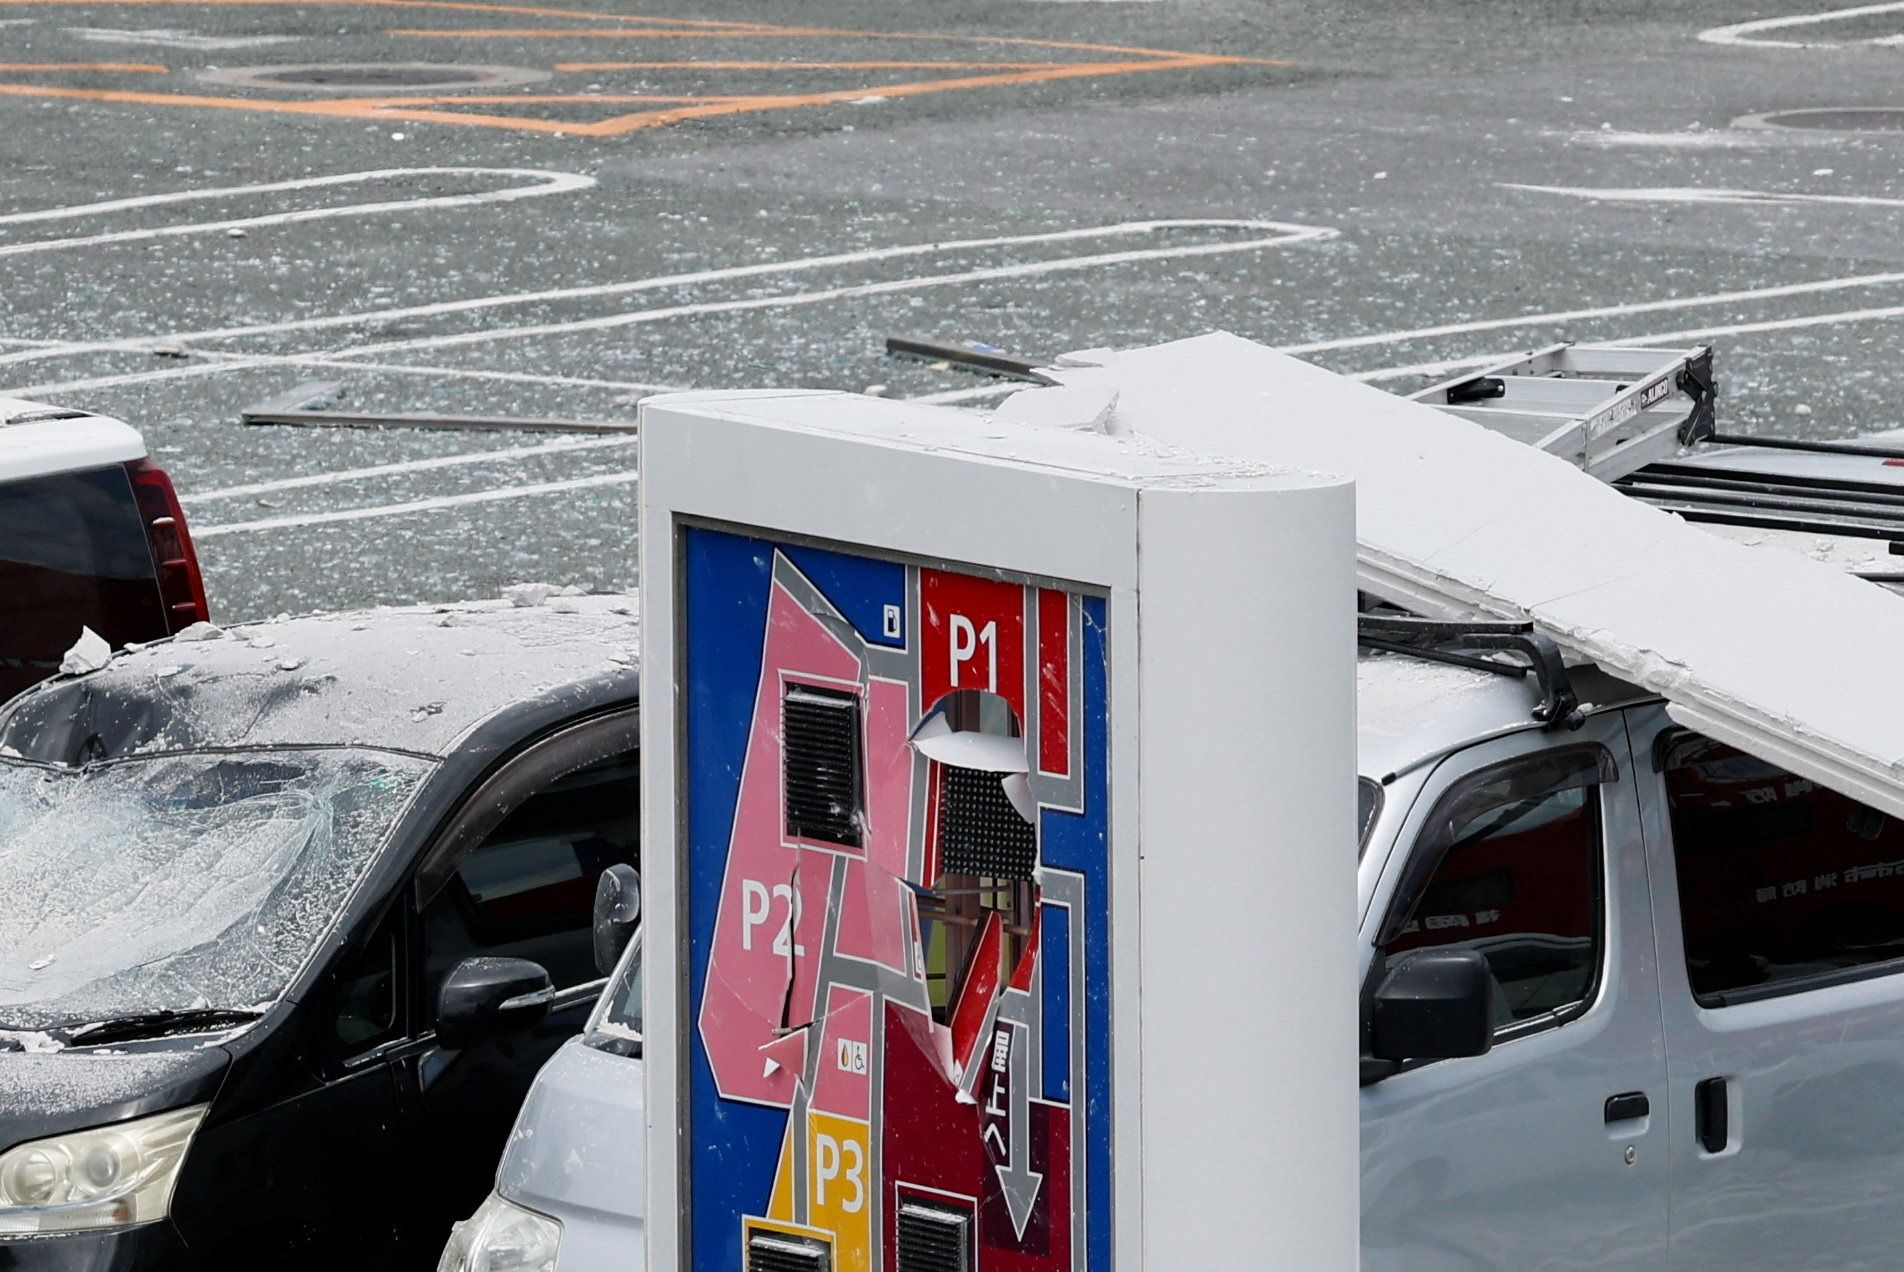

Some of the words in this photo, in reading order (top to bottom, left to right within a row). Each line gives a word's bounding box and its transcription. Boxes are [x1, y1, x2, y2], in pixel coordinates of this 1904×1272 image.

[1647, 379, 1668, 404] ALINCO
[949, 613, 997, 693] P1
[741, 878, 805, 957] P2
[984, 1030, 1010, 1156] 屋上へ
[815, 1133, 864, 1213] P3
